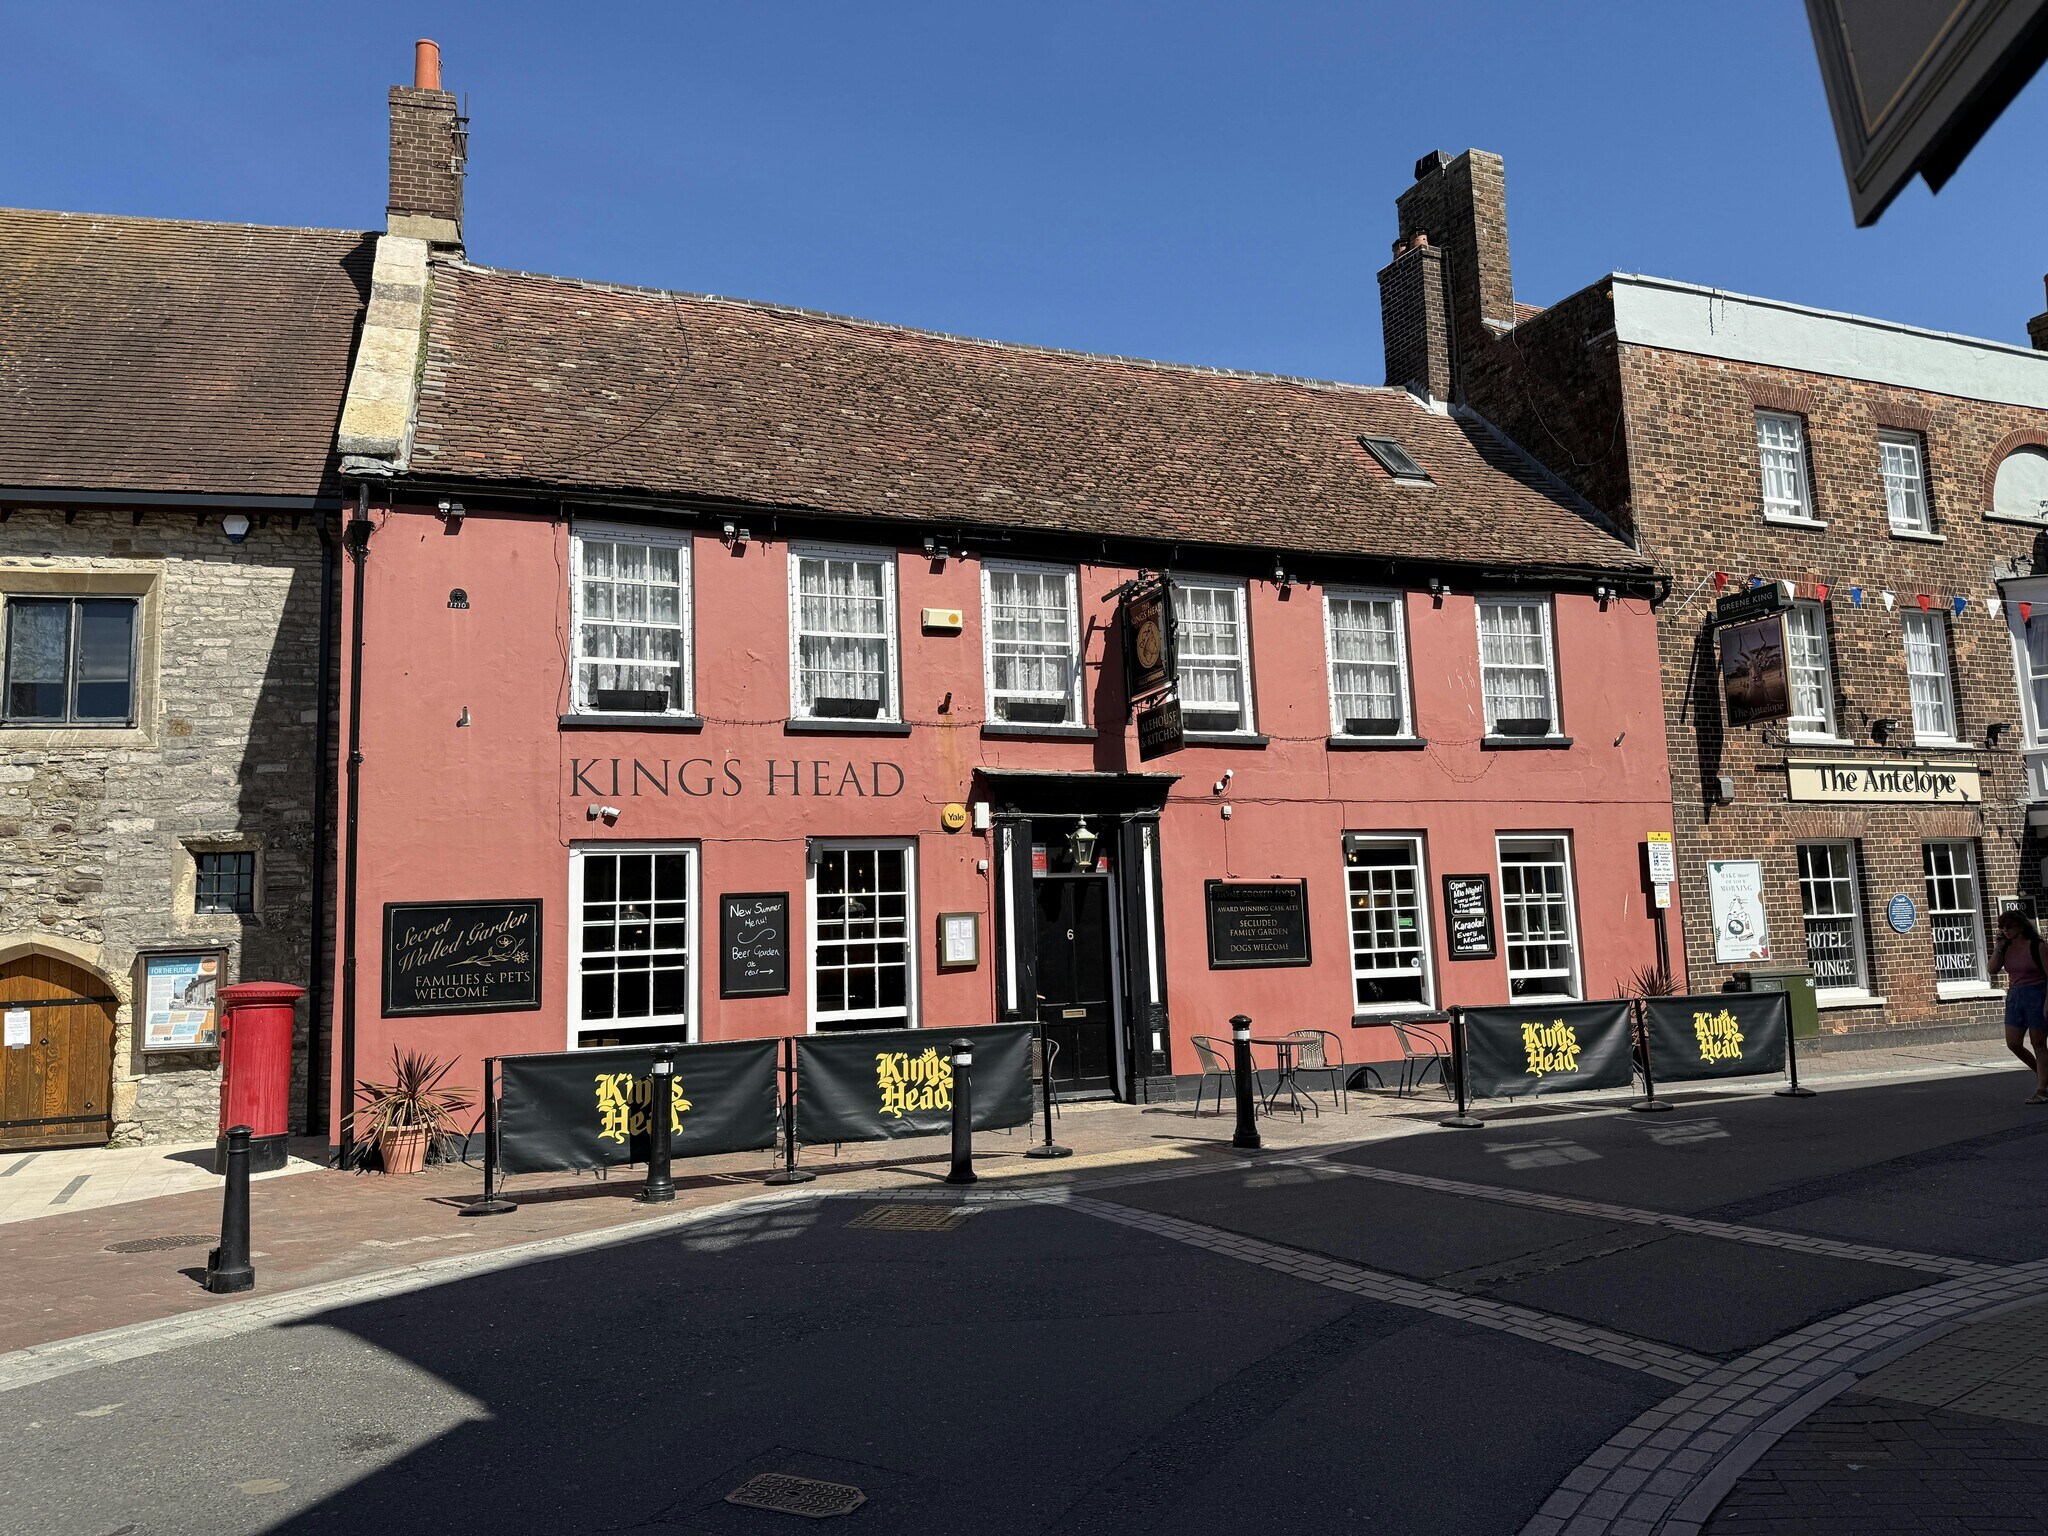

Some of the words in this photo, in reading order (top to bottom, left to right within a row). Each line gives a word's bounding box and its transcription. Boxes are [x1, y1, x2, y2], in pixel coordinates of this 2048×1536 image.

[1720, 597, 1750, 612] GREENE
[1752, 591, 1773, 604] KING
[1148, 602, 1163, 617] HEAD
[1734, 709, 1748, 718] The
[1750, 703, 1784, 716] Antelope
[1141, 711, 1177, 733] ALEHOUSE
[1141, 737, 1147, 748] &
[1147, 727, 1180, 746] KITCHEN
[570, 758, 743, 797] KINGS
[766, 760, 905, 797] HEAD
[1815, 764, 1858, 792] The
[1863, 765, 1957, 800] Antelope
[947, 813, 964, 821] Yale
[1241, 890, 1273, 898] COOKED
[1275, 889, 1297, 897] FOOD
[1450, 882, 1466, 890] Open
[1465, 884, 1483, 896] Night!
[1720, 884, 1752, 892] MORNING
[1453, 897, 1468, 905] Every
[1458, 900, 1482, 908] Thursday
[2006, 902, 2027, 911] FOOD
[730, 904, 751, 918] New
[754, 902, 781, 914] Summer
[744, 916, 768, 928] Menu!
[1240, 919, 1278, 928] SECLUDED
[1454, 917, 1485, 931] Karaoke!
[395, 917, 452, 950] Secret
[1067, 929, 1074, 940] 6
[1230, 929, 1256, 937] FAMILY
[1257, 928, 1288, 936] GARDEN
[1457, 930, 1477, 939] Every
[1463, 934, 1486, 944] Month
[399, 931, 464, 973] Walled
[466, 910, 529, 946] Garden
[1230, 944, 1252, 952] DOGS
[1253, 943, 1289, 951] WELCOME
[732, 946, 751, 960] Beer
[753, 944, 780, 958] Garden
[747, 960, 757, 968] at
[1813, 960, 1853, 976] OUNGE
[1935, 954, 1974, 970] OUNGE
[151, 967, 162, 975] FOR
[173, 966, 193, 974] FUTURE
[744, 969, 759, 977] rear
[415, 973, 480, 987] FAMILIES
[484, 972, 495, 985] &
[500, 971, 531, 983] PETS
[415, 986, 489, 1000] WELCOME
[1693, 1012, 1739, 1040] Kings
[1521, 1022, 1576, 1052] Kings
[1697, 1033, 1745, 1065] Head
[1525, 1044, 1581, 1078] Head
[875, 1052, 951, 1087] Kings
[594, 1073, 684, 1110] Kins
[878, 1077, 953, 1119] Head
